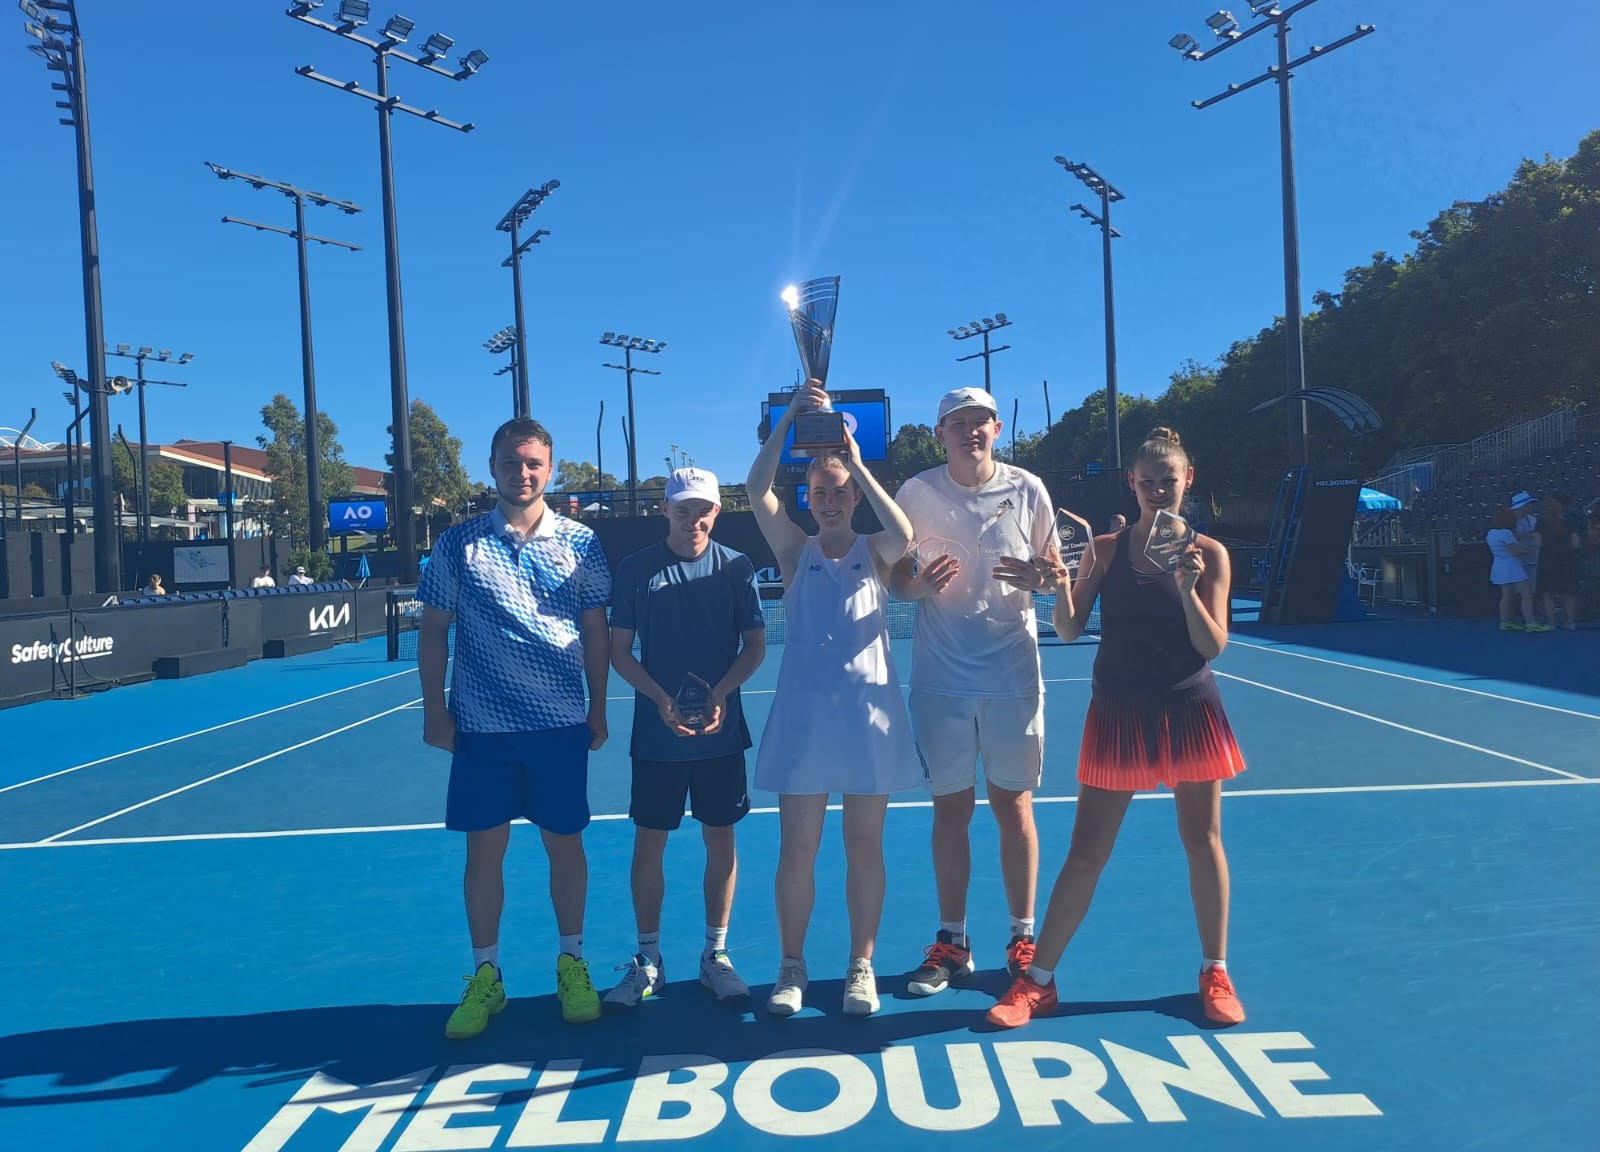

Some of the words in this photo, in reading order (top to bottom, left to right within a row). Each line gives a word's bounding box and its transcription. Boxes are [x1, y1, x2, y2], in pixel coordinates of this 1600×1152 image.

[343, 505, 373, 520] AO
[309, 602, 350, 632] KIA
[239, 1031, 1385, 1152] MELBOURNE
